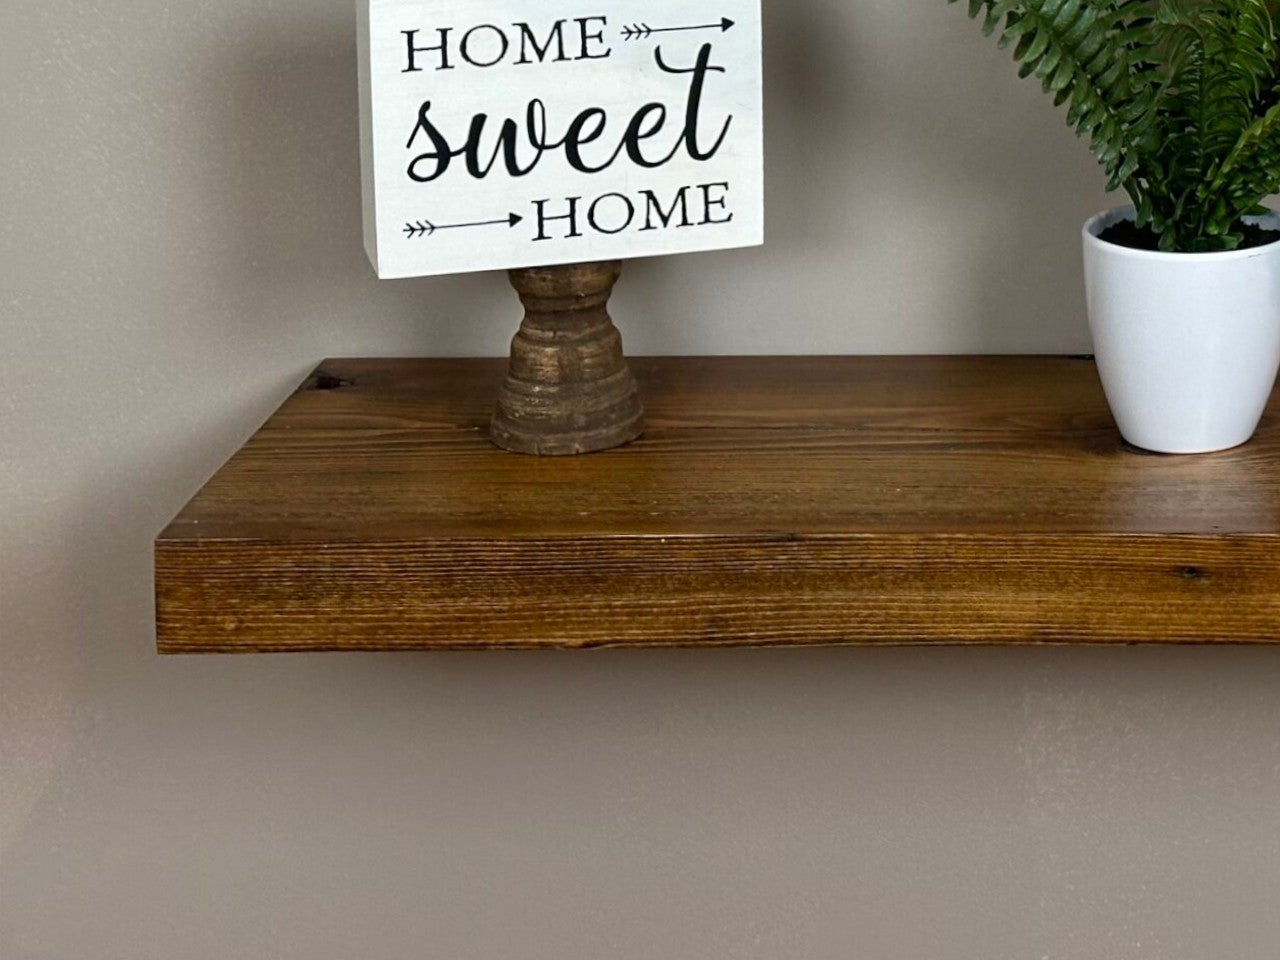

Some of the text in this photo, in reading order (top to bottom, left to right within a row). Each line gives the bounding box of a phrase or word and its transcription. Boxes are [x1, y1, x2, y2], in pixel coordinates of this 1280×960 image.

[401, 16, 611, 73] HOME
[406, 43, 732, 182] sweet
[530, 182, 734, 241] HOME
